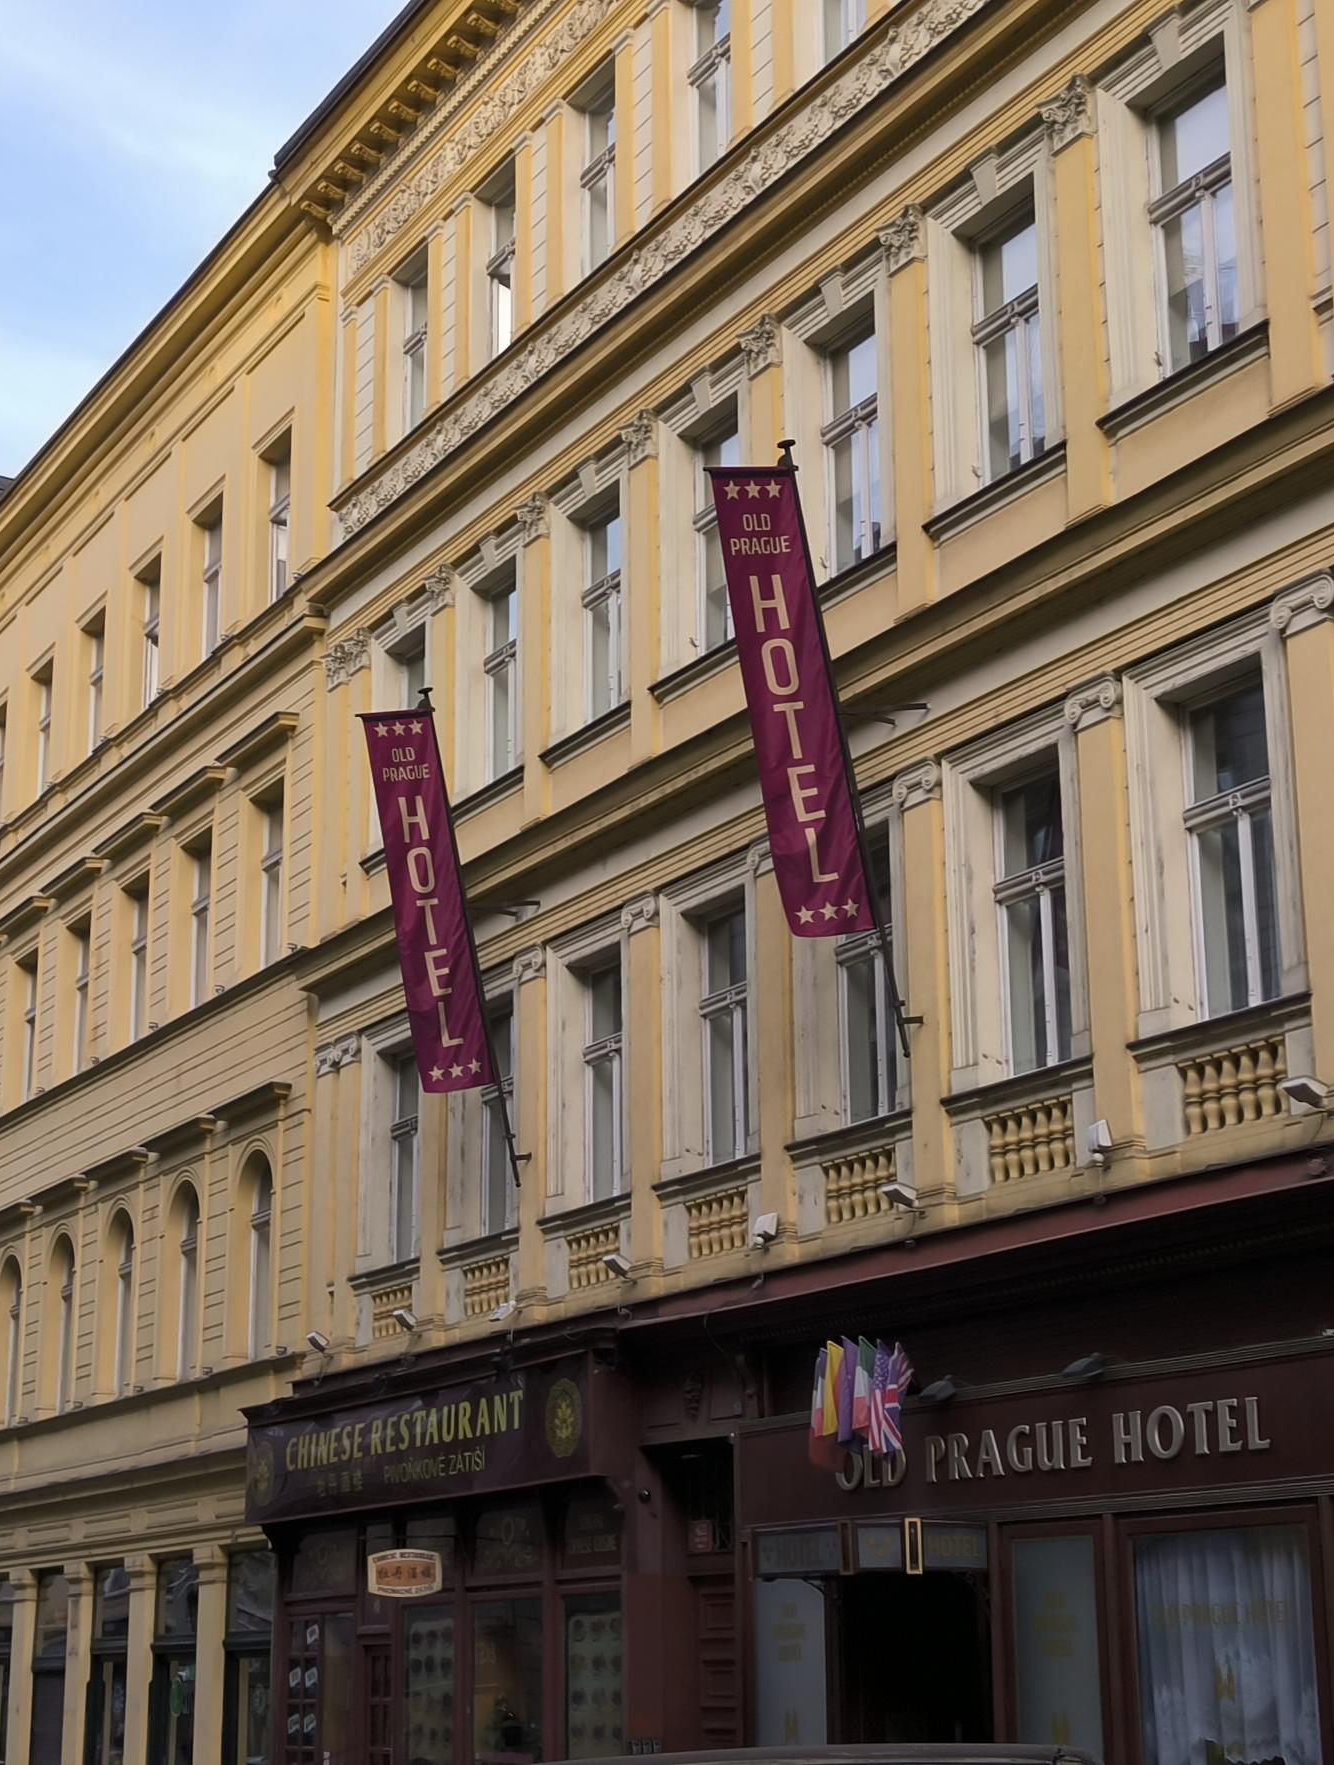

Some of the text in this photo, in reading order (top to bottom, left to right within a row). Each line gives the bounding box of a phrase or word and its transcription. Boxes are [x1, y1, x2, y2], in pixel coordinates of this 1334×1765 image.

[730, 535, 791, 556] PRAGUE
[742, 513, 772, 532] OLD
[391, 746, 416, 763] OLD
[749, 573, 839, 884] HOTEL
[382, 763, 430, 783] PRAGUE
[398, 795, 465, 1048] HOTEL
[285, 1389, 524, 1472] CHINESE RESTAURANT
[924, 1417, 1093, 1483] PRAGUE
[1112, 1396, 1271, 1464] HOTEL
